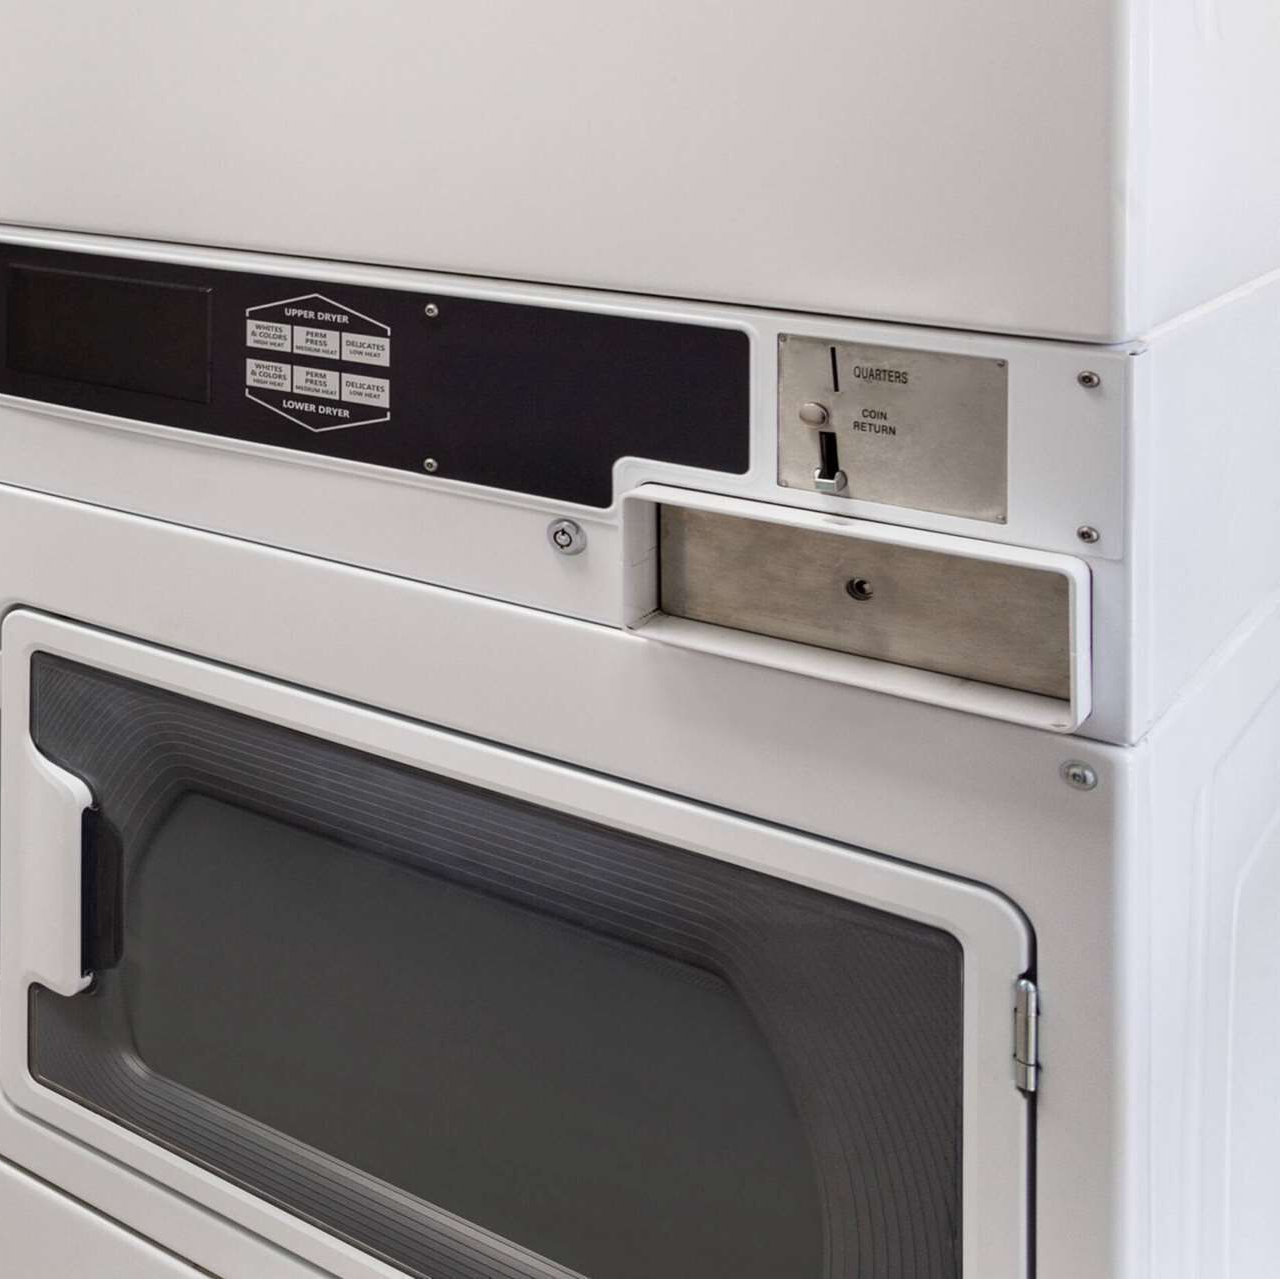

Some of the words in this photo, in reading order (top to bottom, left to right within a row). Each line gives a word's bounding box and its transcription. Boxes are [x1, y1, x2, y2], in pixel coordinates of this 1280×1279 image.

[284, 307, 315, 320] UPPER
[317, 312, 350, 324] DRYER
[255, 323, 283, 333] WHITES
[259, 331, 288, 341] COLORS
[306, 330, 327, 339] PERM
[305, 338, 328, 347] PRESS
[345, 339, 386, 352] DELICATES
[254, 362, 283, 373] WHITES
[258, 370, 287, 381] COLORS
[305, 370, 327, 379] PERM
[853, 365, 909, 385] QUARTERS
[305, 378, 328, 387] PRESS
[345, 380, 385, 393] DELICATES
[366, 392, 381, 400] HEAT
[282, 399, 317, 413] LOWER
[318, 405, 350, 418] DRYER
[861, 408, 888, 421] COIN
[852, 420, 897, 436] RETURN
